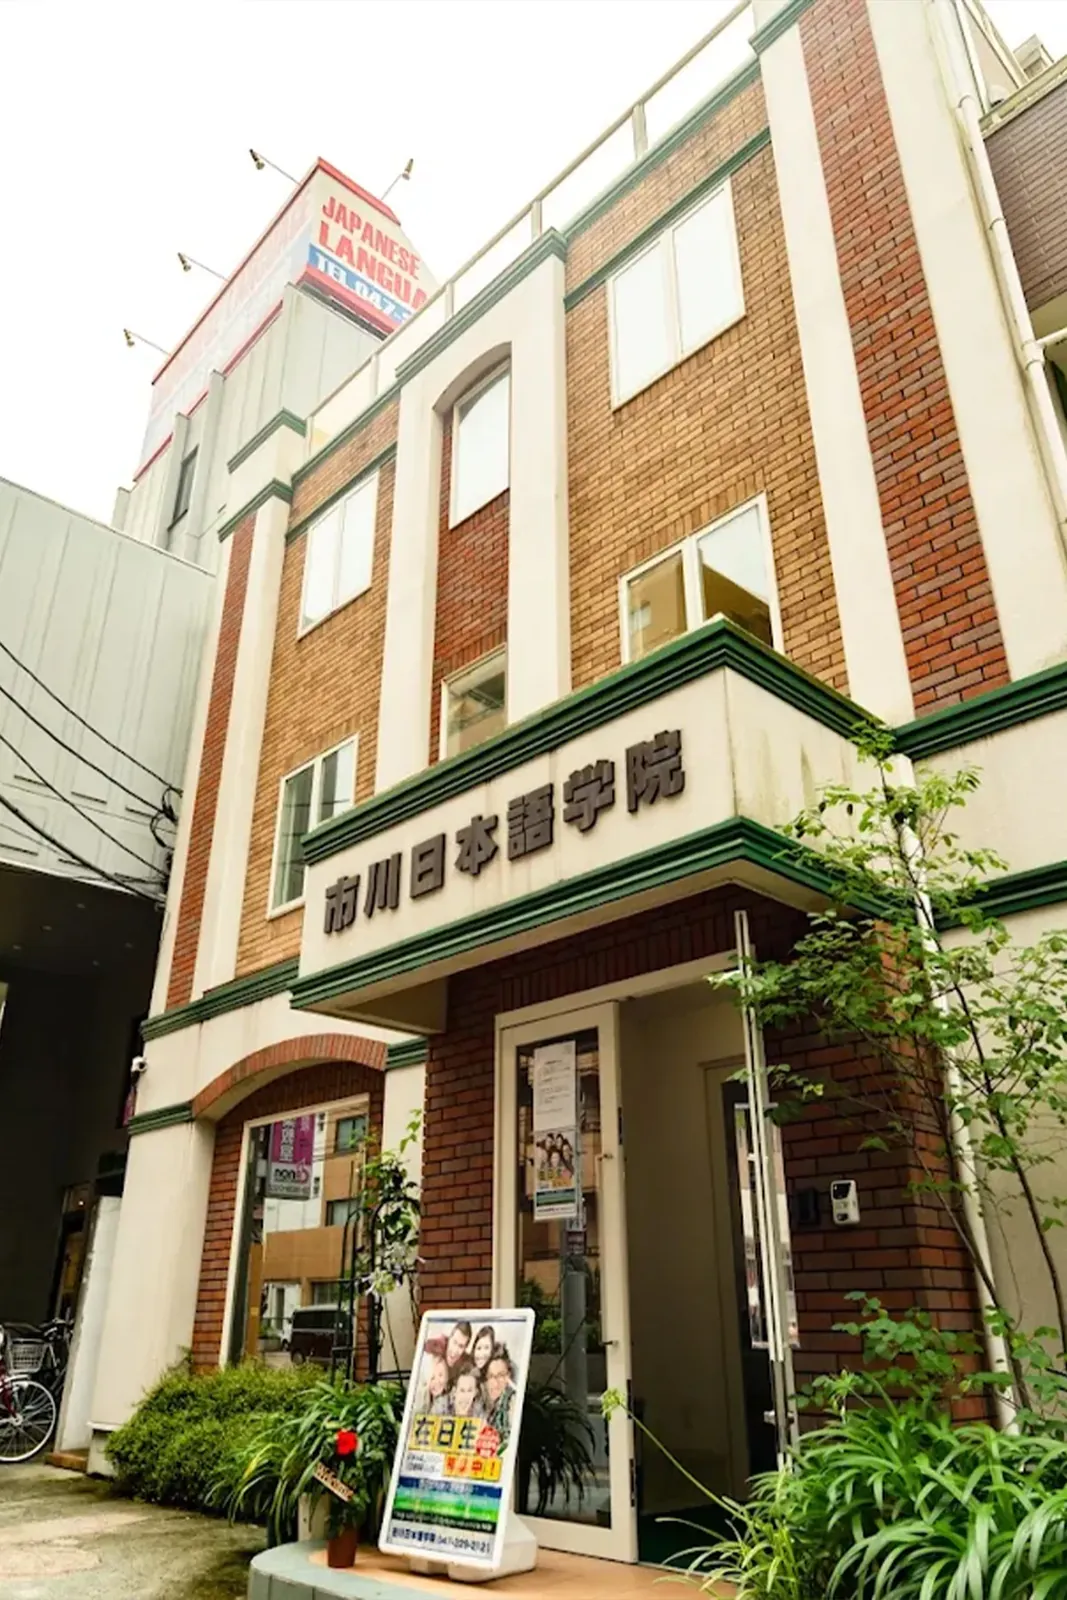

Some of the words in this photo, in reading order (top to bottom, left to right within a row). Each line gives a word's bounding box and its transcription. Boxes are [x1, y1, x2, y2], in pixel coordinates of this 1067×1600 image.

[316, 252, 347, 290] TEL
[322, 196, 421, 280] JAPANESE
[323, 728, 686, 935] 市川日本語学院
